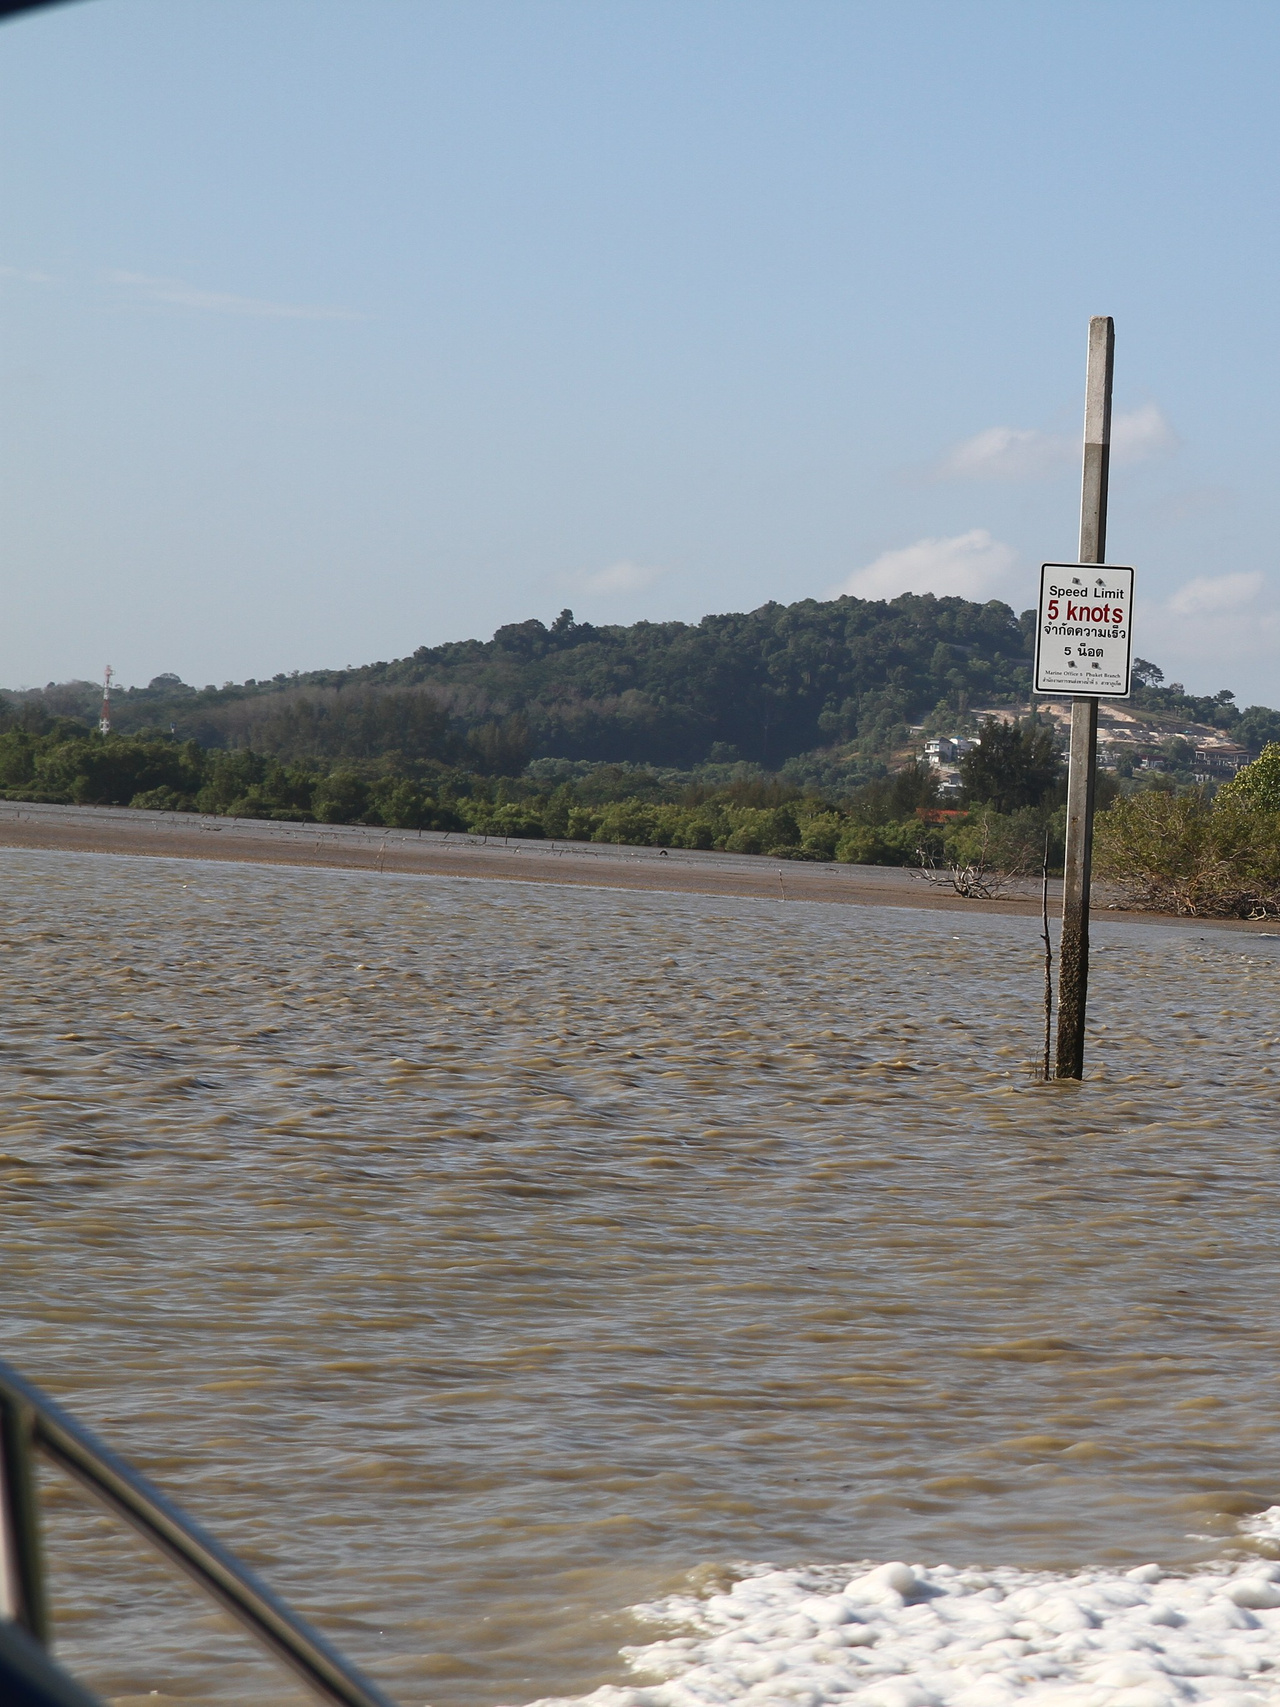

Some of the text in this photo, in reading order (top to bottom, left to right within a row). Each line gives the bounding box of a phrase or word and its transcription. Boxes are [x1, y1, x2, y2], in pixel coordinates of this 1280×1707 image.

[1049, 585, 1124, 599] Speed Limit
[1047, 600, 1123, 623] 5 knots
[1044, 621, 1126, 639] จำกัดความเร็ว
[1064, 646, 1071, 656] 5
